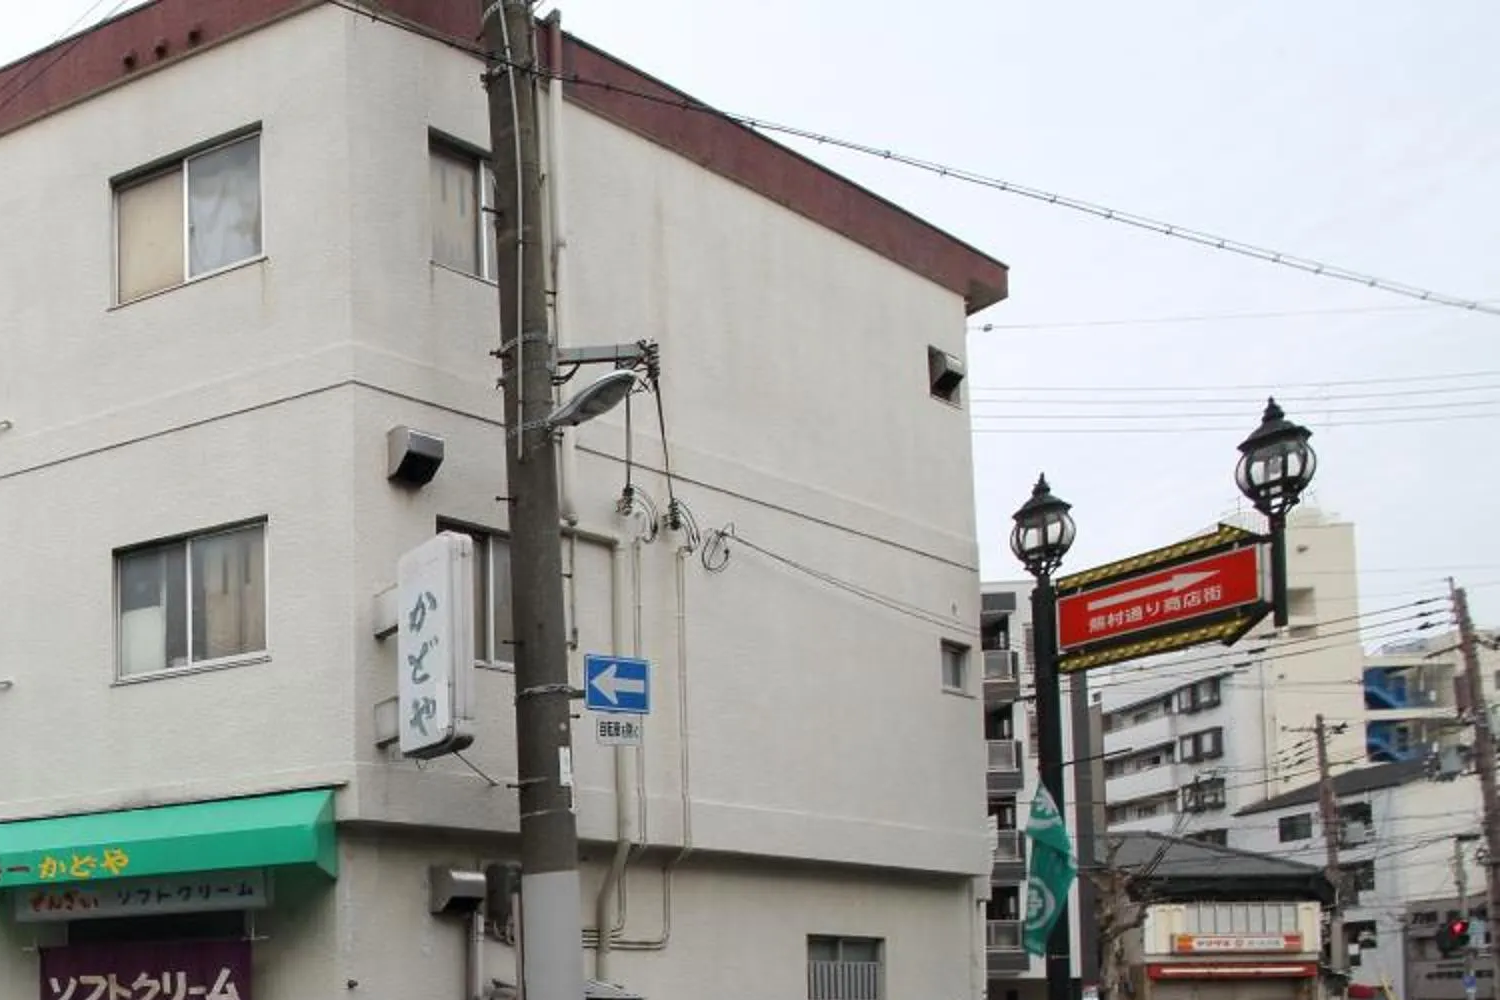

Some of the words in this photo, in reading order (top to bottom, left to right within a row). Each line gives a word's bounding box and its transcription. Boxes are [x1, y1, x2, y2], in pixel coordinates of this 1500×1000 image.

[408, 591, 438, 737] かどや
[116, 882, 254, 906] ソフトクリーム
